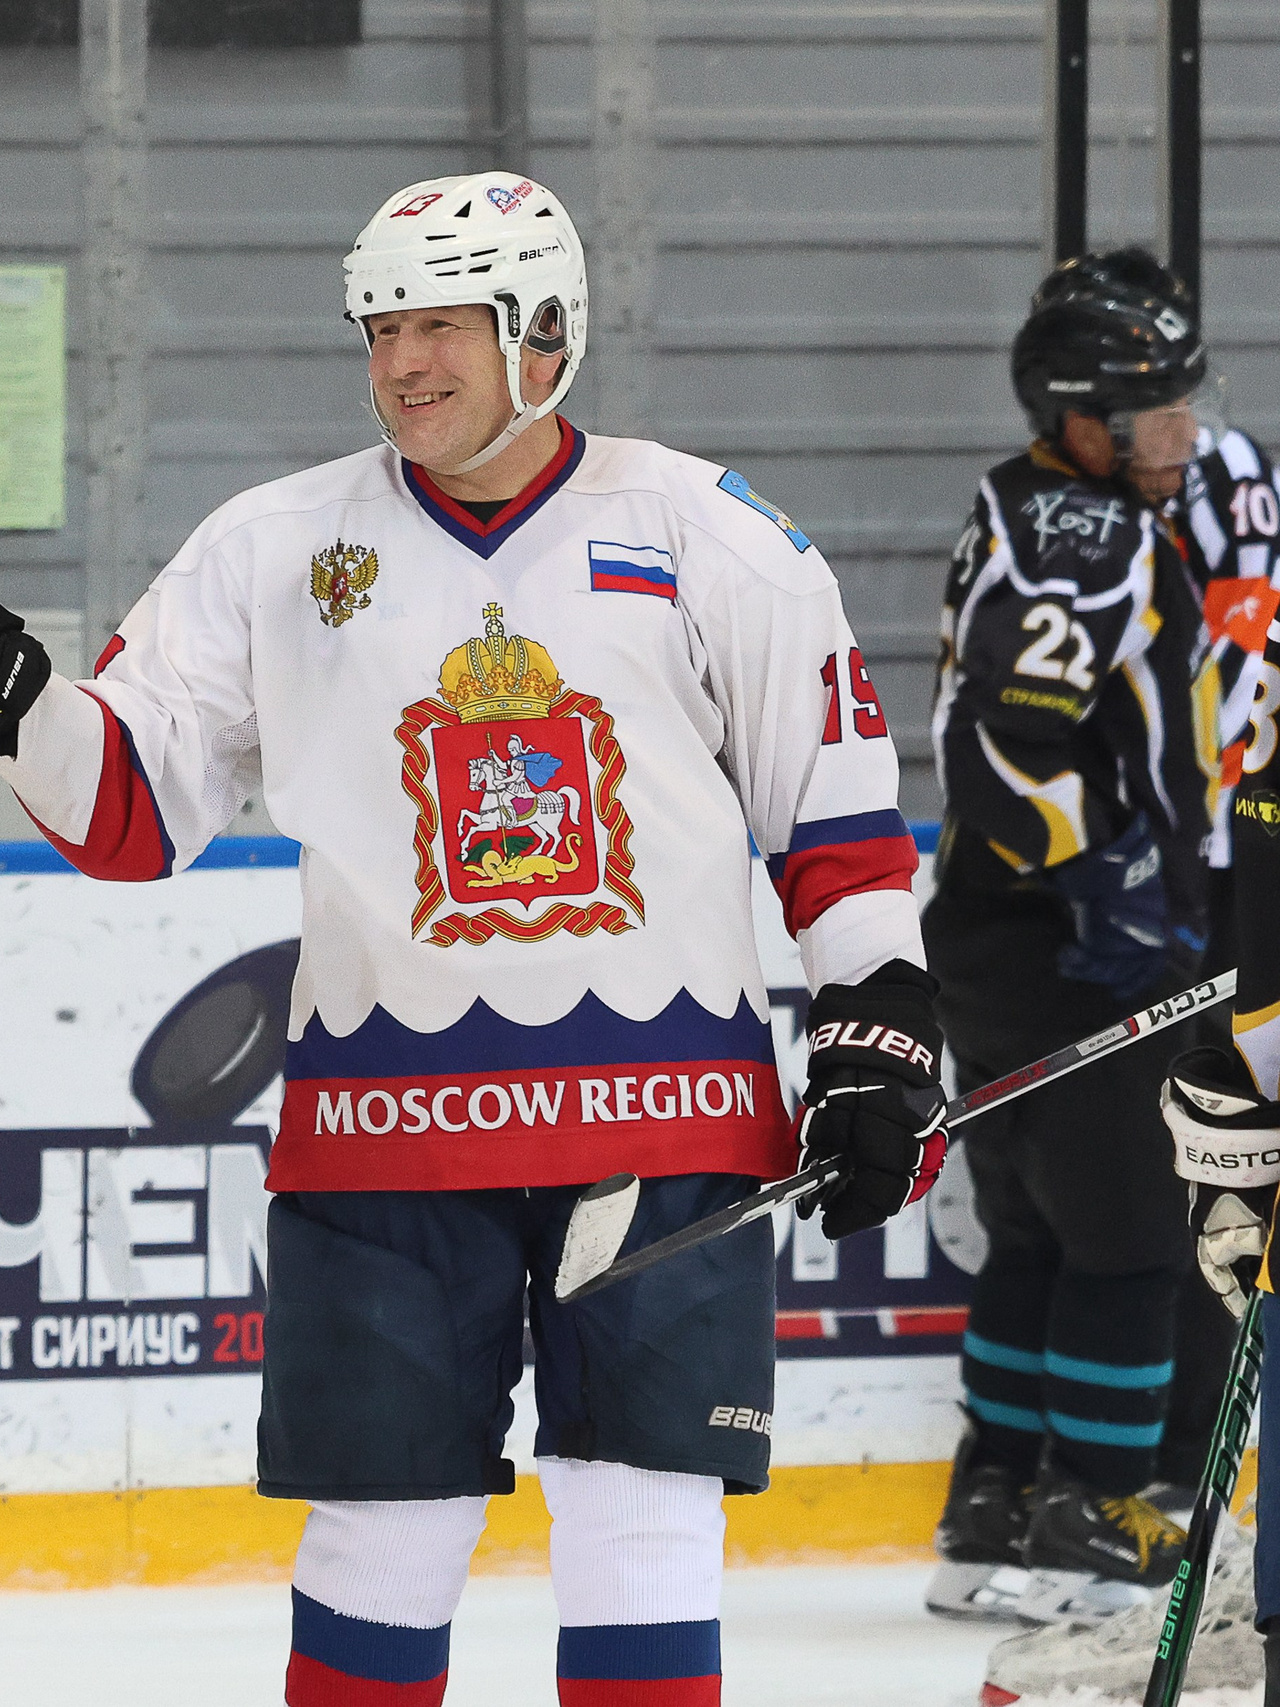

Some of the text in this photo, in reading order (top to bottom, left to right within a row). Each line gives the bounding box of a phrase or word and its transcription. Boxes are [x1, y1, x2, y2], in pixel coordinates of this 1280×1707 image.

[1, 651, 24, 700] BAUER
[1014, 602, 1096, 691] 22
[1148, 982, 1218, 1027] CCM
[314, 1072, 756, 1136] MOSCOW REGION
[31, 1313, 200, 1369] СИРИУС
[1157, 1558, 1192, 1660] BAUER
